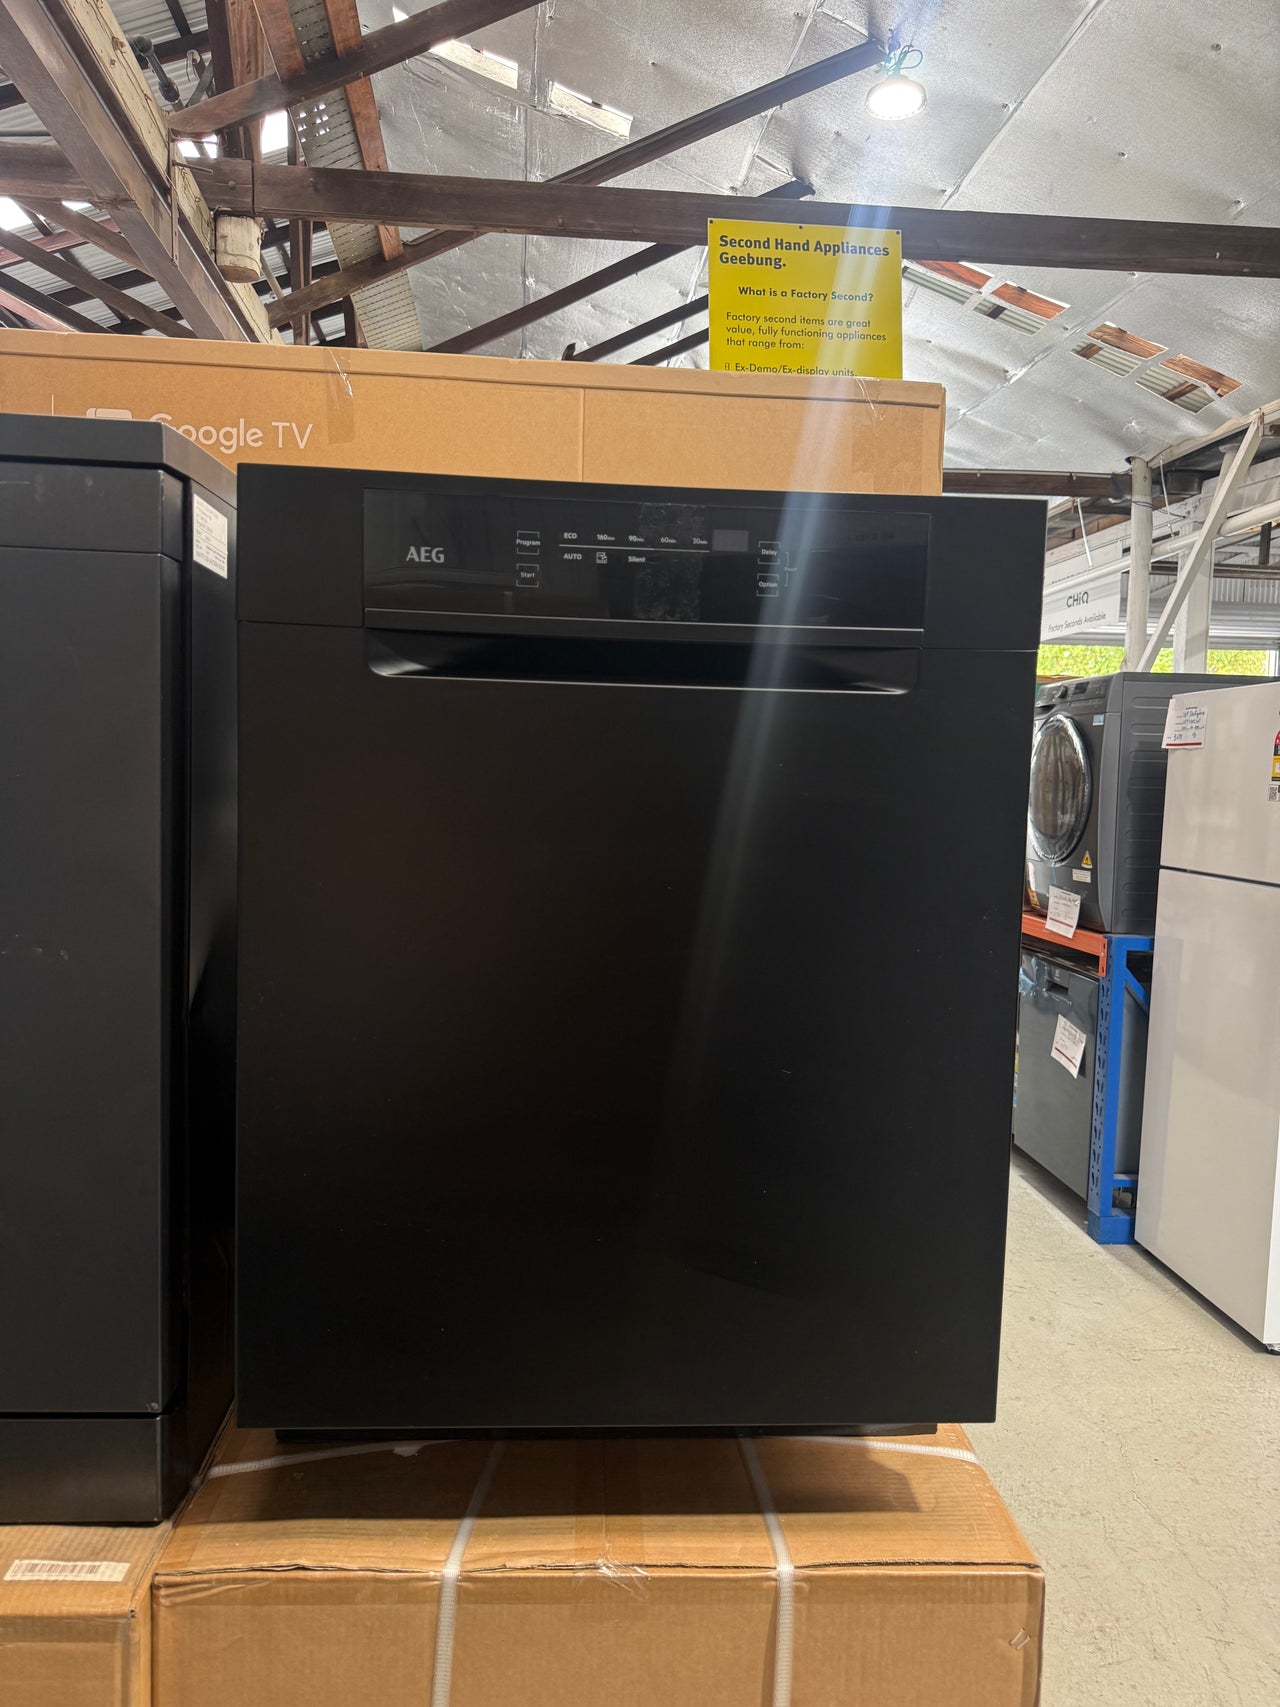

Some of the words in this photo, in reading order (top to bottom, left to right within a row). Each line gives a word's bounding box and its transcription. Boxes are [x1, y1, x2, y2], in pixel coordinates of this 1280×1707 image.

[719, 235, 770, 250] Second
[775, 238, 810, 252] Hand
[813, 240, 890, 257] Appliances
[719, 252, 786, 269] Geebung.
[738, 286, 766, 297] What
[769, 288, 778, 297] is
[791, 289, 828, 301] Factory
[831, 291, 873, 302] Second?
[726, 312, 761, 324] Factory
[763, 314, 797, 324] second
[800, 315, 825, 326] items
[827, 319, 843, 327] are
[846, 319, 871, 329] great
[726, 326, 755, 336] value,
[758, 326, 778, 338] fully
[781, 327, 834, 340] functioning
[836, 330, 886, 341] appliances
[726, 337, 745, 347] that
[748, 341, 776, 349] range
[779, 340, 804, 349] from:
[272, 421, 313, 449] TV
[516, 538, 541, 547] Program
[563, 532, 578, 540] ECO
[406, 546, 445, 564] AEG
[628, 555, 646, 563] Silent
[761, 548, 778, 556] Delay
[520, 571, 535, 579] Start
[758, 580, 778, 588] Option
[1066, 591, 1089, 608] CHiQ
[1048, 623, 1064, 633] Factory
[1064, 617, 1083, 629] Seconds
[1084, 611, 1106, 623] Available
